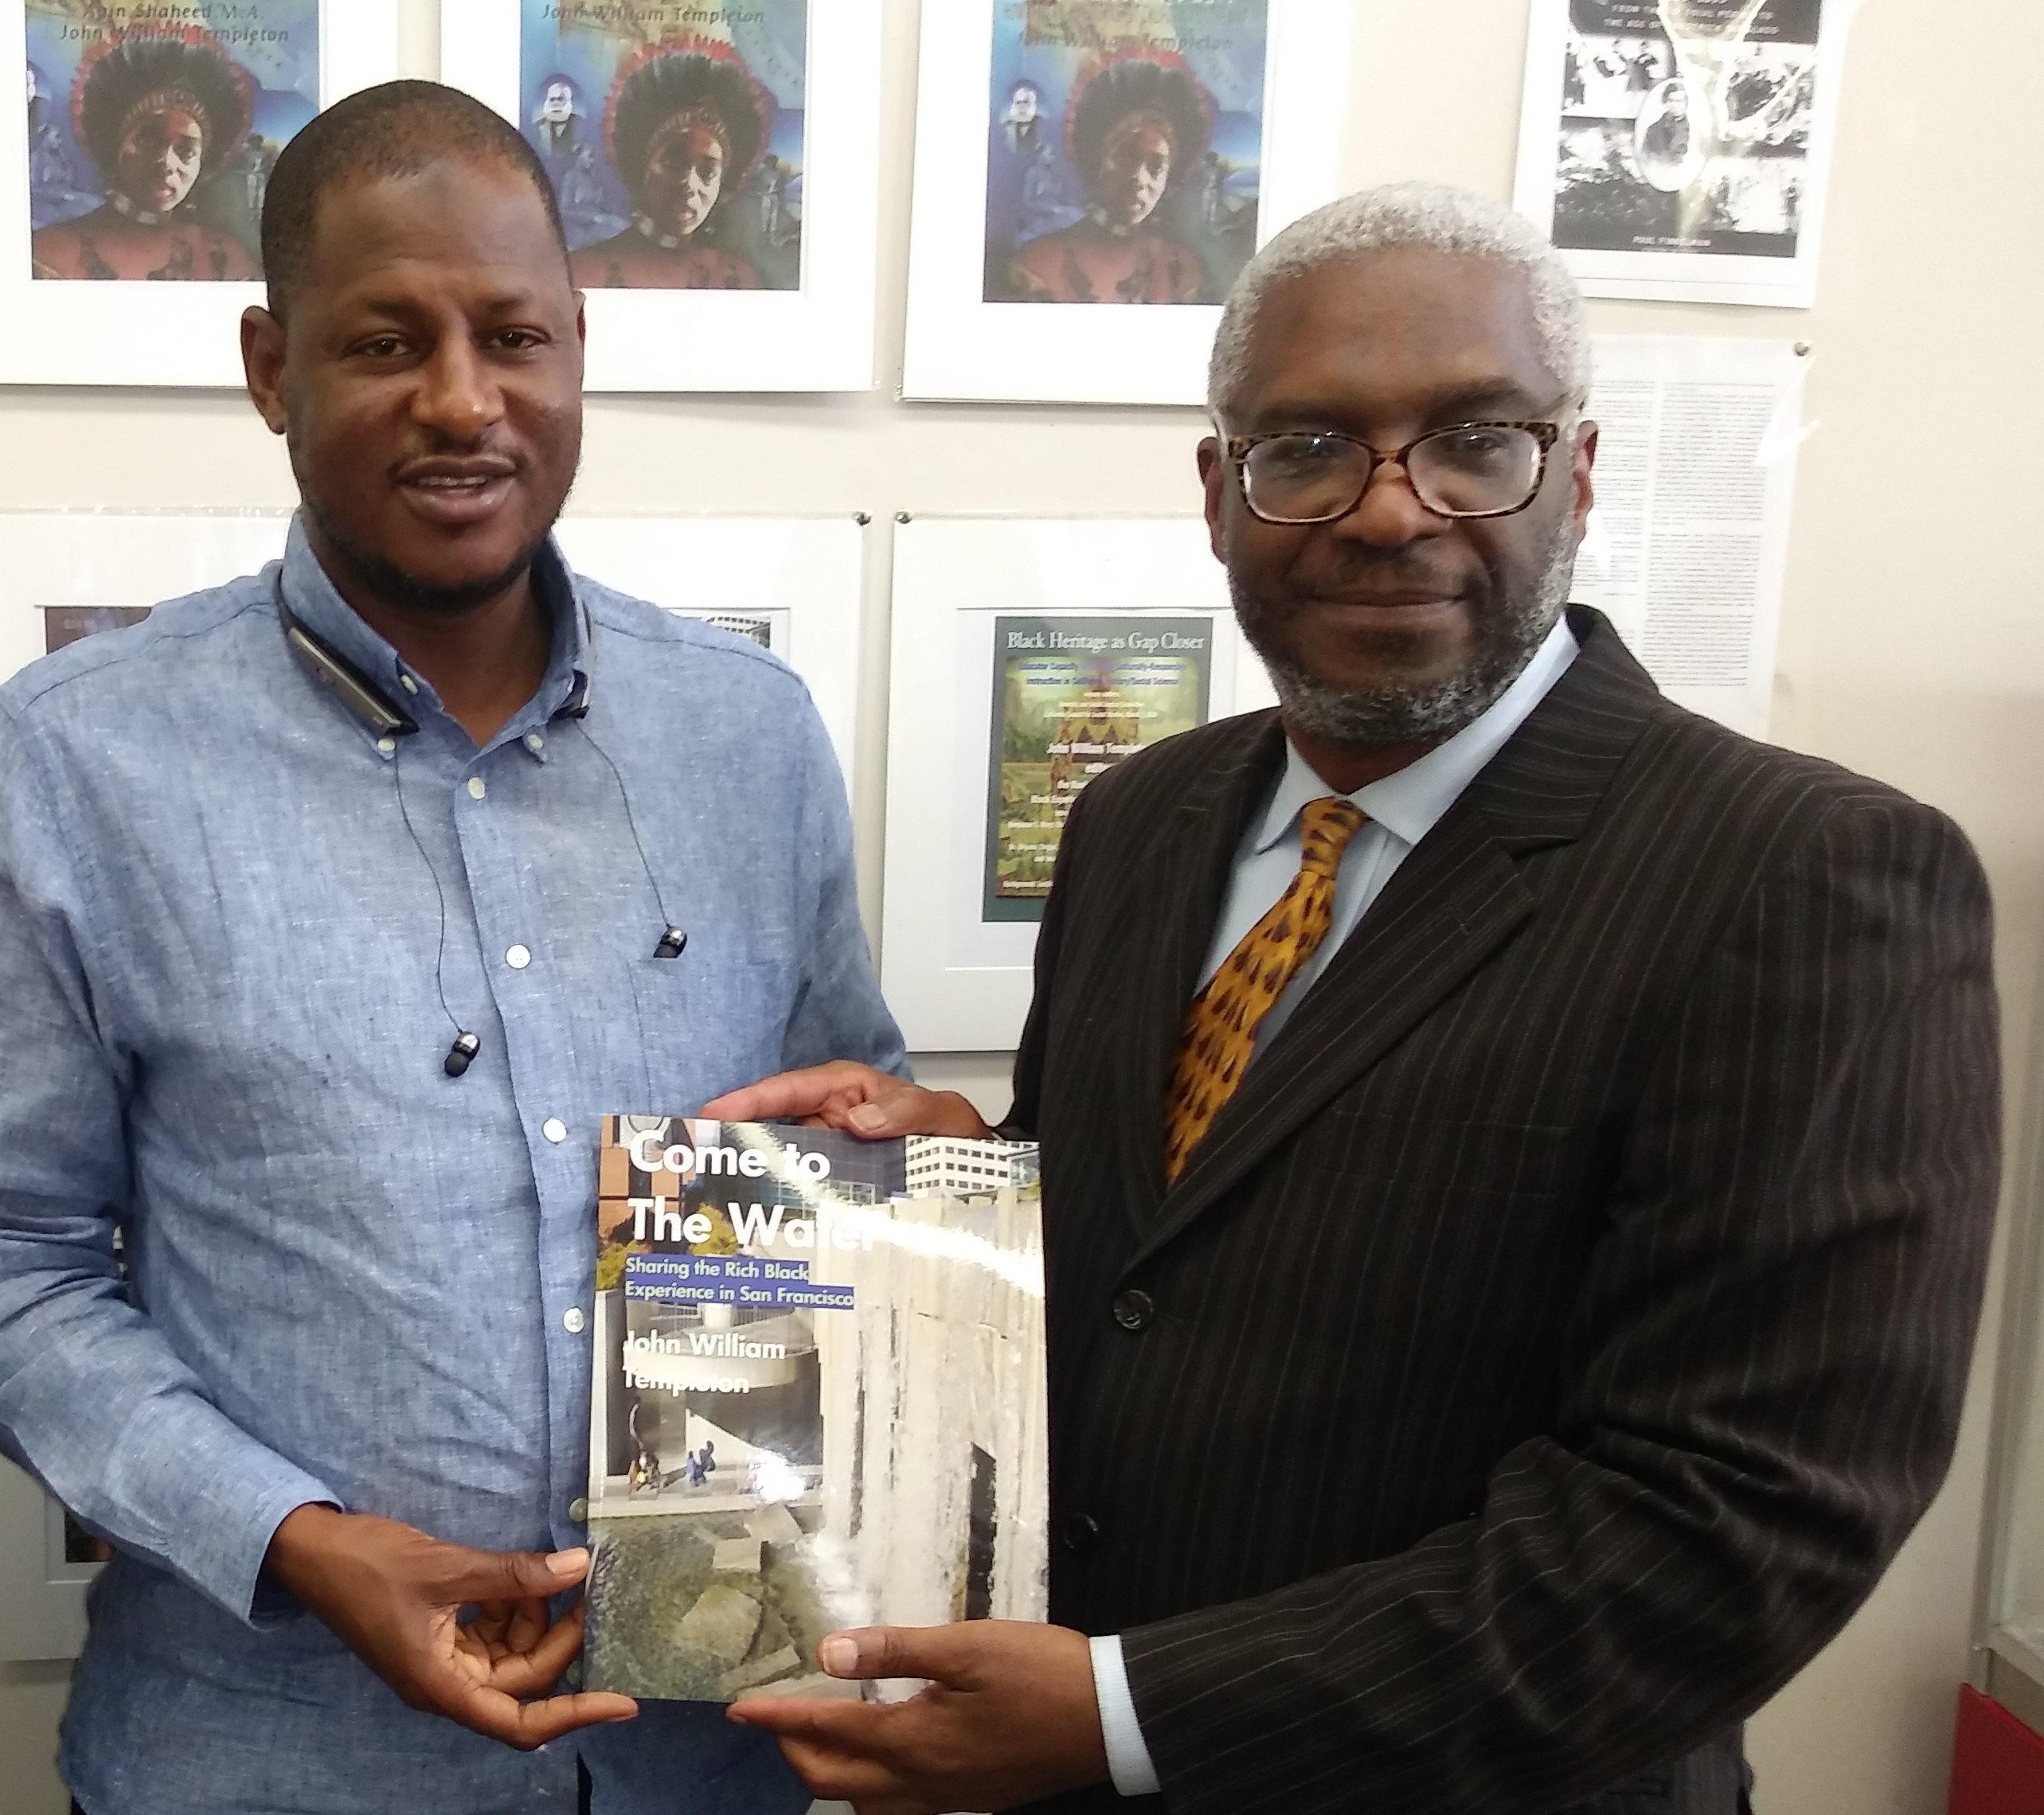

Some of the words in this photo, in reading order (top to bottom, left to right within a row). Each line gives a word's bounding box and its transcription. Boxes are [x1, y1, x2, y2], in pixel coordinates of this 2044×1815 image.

[674, 6, 764, 24] Templeton
[60, 25, 104, 41] John
[195, 26, 290, 45] Templeton
[1007, 631, 1045, 649] Black
[1049, 631, 1108, 654] Heritage
[1111, 637, 1125, 649] as
[1128, 631, 1159, 654] Gap
[1160, 632, 1205, 649] Closer
[630, 1130, 768, 1177] Come
[784, 1142, 831, 1181] to
[627, 1196, 713, 1243] The
[727, 1202, 874, 1251] Water
[625, 1258, 690, 1279] Sharing
[694, 1259, 721, 1276] the
[725, 1261, 760, 1278] Rich
[764, 1262, 809, 1281] Black
[625, 1280, 714, 1301] Experience
[719, 1283, 735, 1301] in
[740, 1286, 772, 1302] San
[776, 1287, 854, 1306] Francisco
[623, 1329, 681, 1355] John
[689, 1332, 786, 1360] William
[623, 1365, 750, 1397] Templeton
